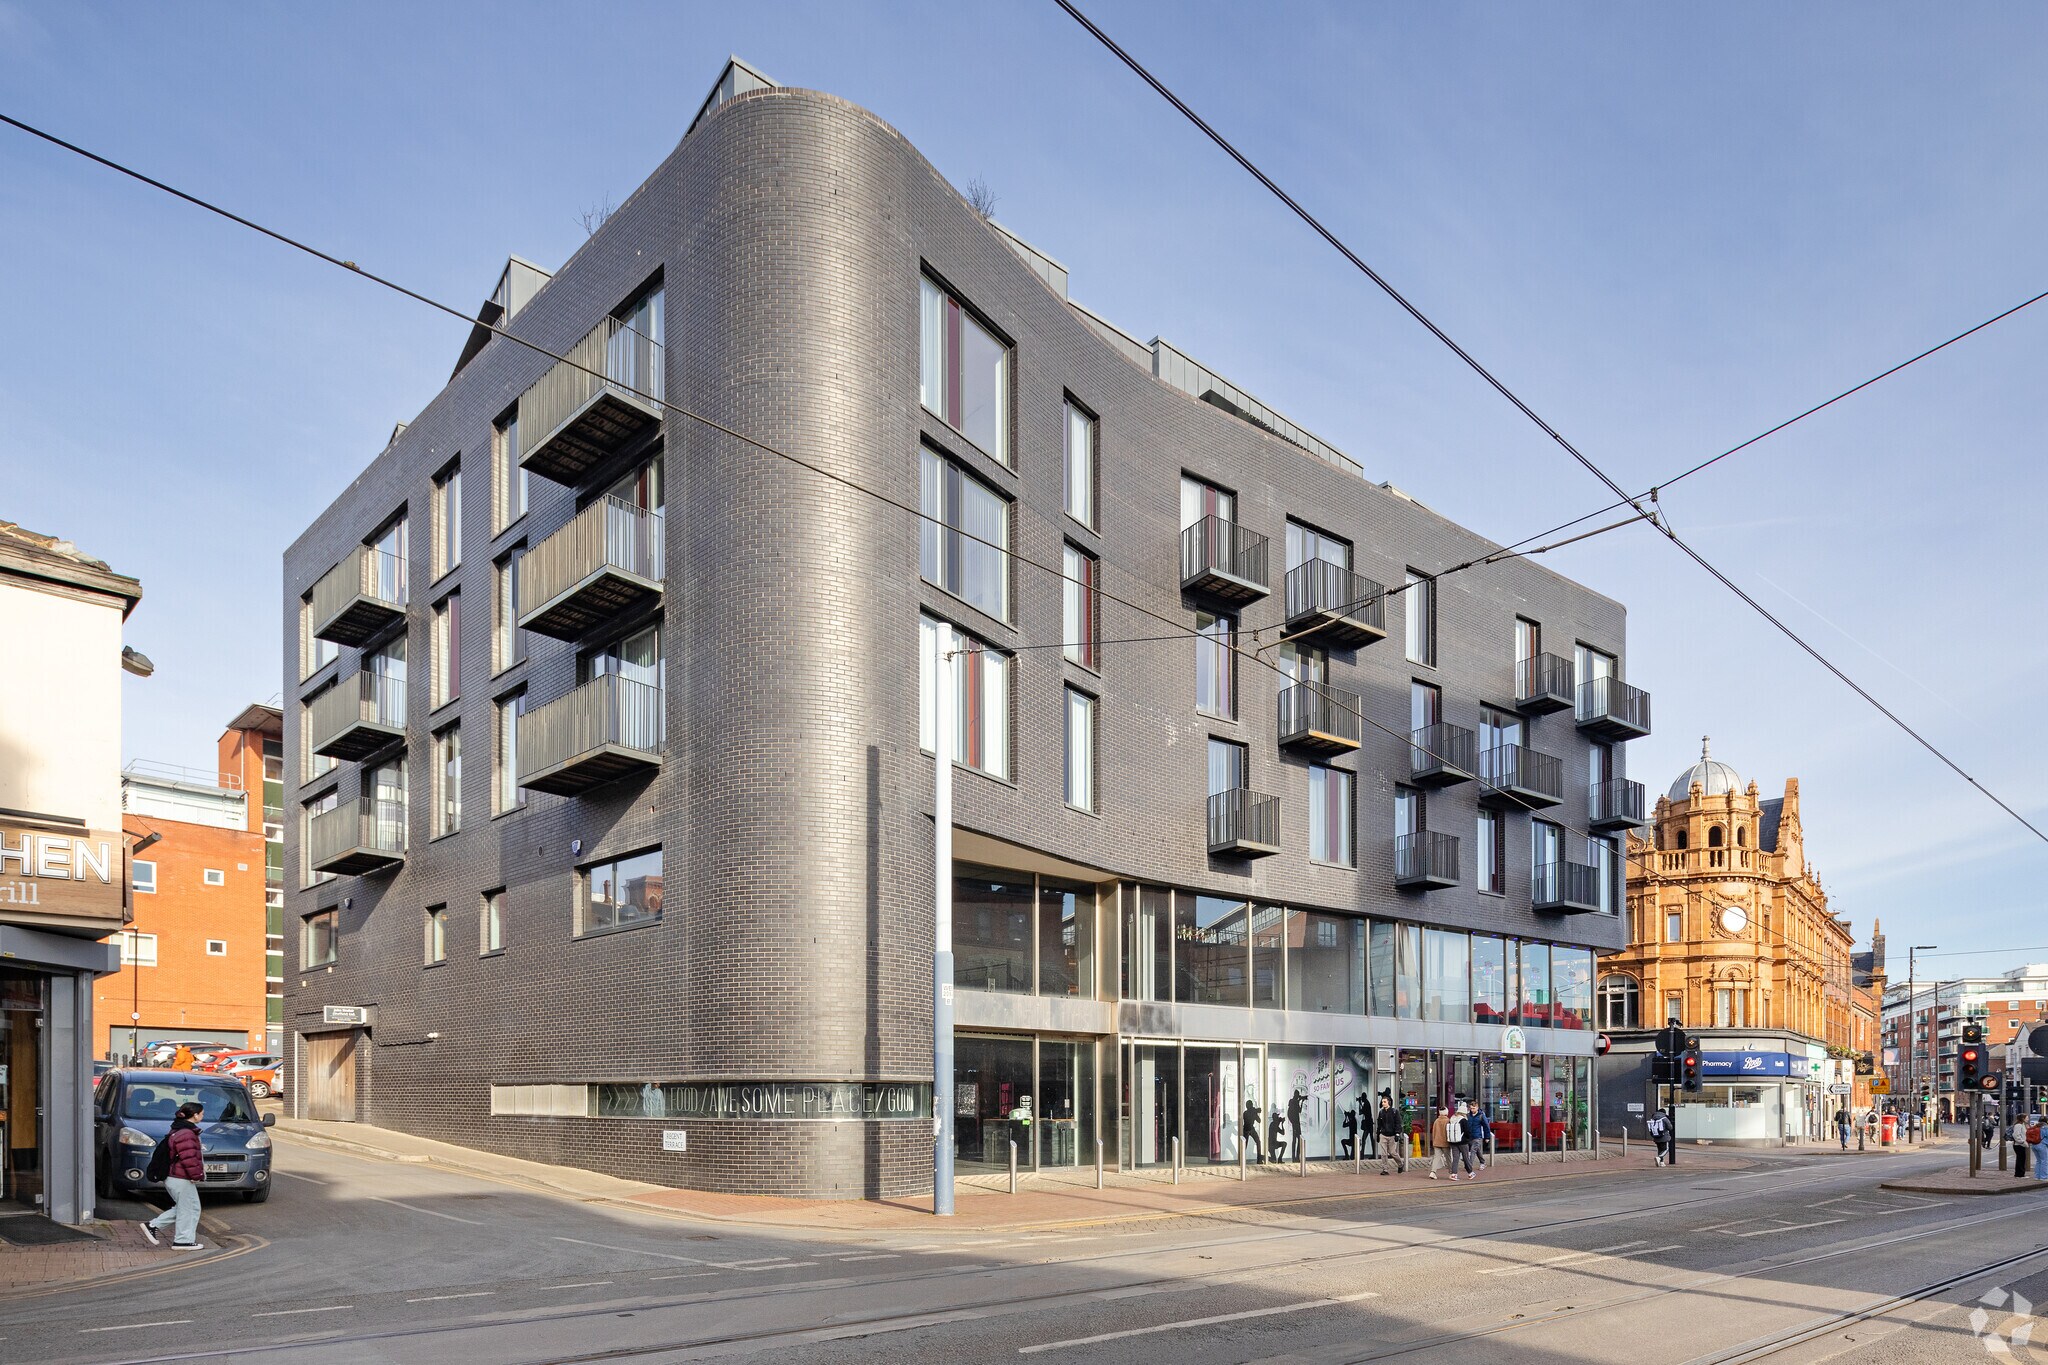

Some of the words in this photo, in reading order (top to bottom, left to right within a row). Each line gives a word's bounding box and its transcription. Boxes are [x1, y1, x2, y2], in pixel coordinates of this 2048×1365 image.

[0, 831, 111, 884] HEN
[1702, 1060, 1732, 1068] Pharmacy
[1743, 1056, 1762, 1070] Boots
[1320, 1077, 1345, 1091] FAMUS
[666, 1132, 683, 1140] REGENT
[665, 1141, 684, 1149] TERRACE
